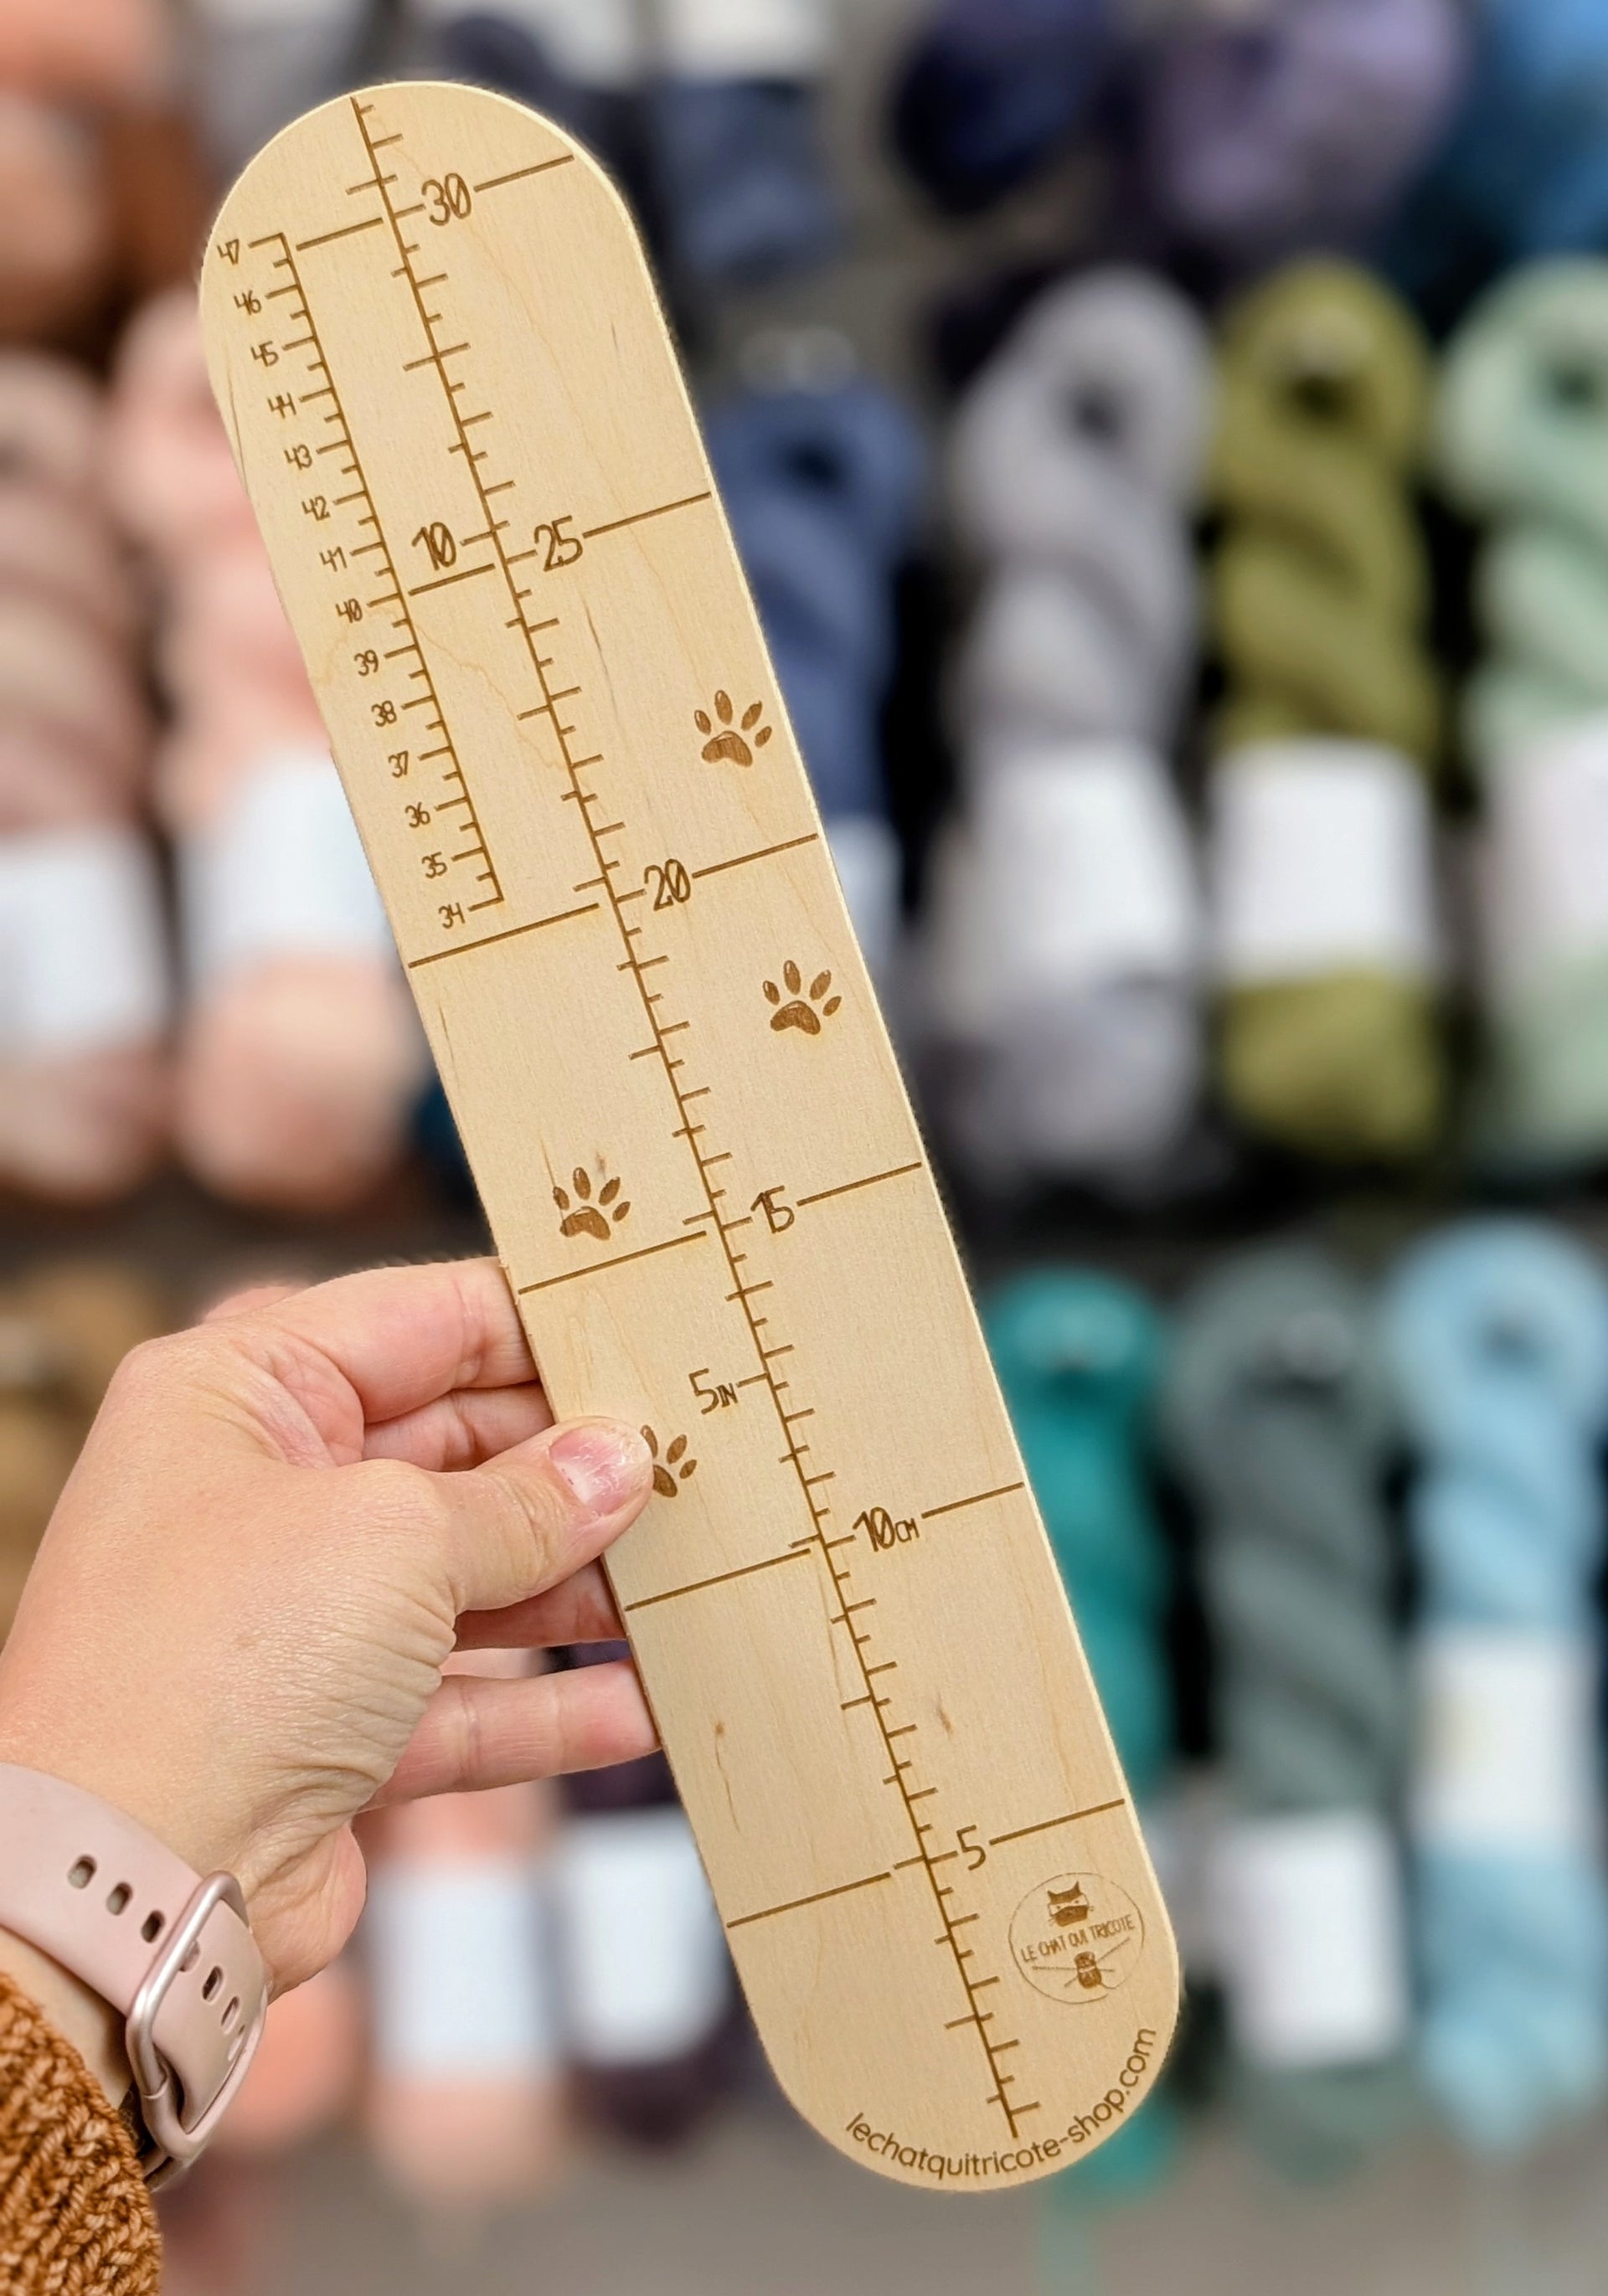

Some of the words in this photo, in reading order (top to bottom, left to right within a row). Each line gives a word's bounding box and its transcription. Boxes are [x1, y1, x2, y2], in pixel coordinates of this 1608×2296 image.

[421, 172, 472, 226] 30
[217, 239, 240, 265] 47
[234, 290, 261, 315] 46
[251, 341, 279, 366] 45
[268, 393, 296, 418] 44
[284, 445, 312, 470] 43
[302, 496, 330, 520] 42
[411, 522, 456, 570] 10
[534, 515, 583, 572] 25
[319, 547, 347, 573] 41
[336, 598, 363, 623] 40
[353, 649, 379, 677] 39
[371, 700, 397, 727] 38
[388, 751, 409, 778] 37
[405, 801, 430, 828] 36
[421, 852, 447, 878] 35
[644, 858, 691, 911] 20
[438, 903, 466, 929] 34
[750, 1185, 795, 1233] 15
[956, 1824, 987, 1871] 5
[1021, 1944, 1037, 1963] LE
[1038, 1936, 1068, 1956] CHAT
[1068, 1928, 1089, 1947] QUI
[1088, 1914, 1135, 1940] TRICOTE
[845, 2028, 1157, 2180] lechatquitricote-shop.com
